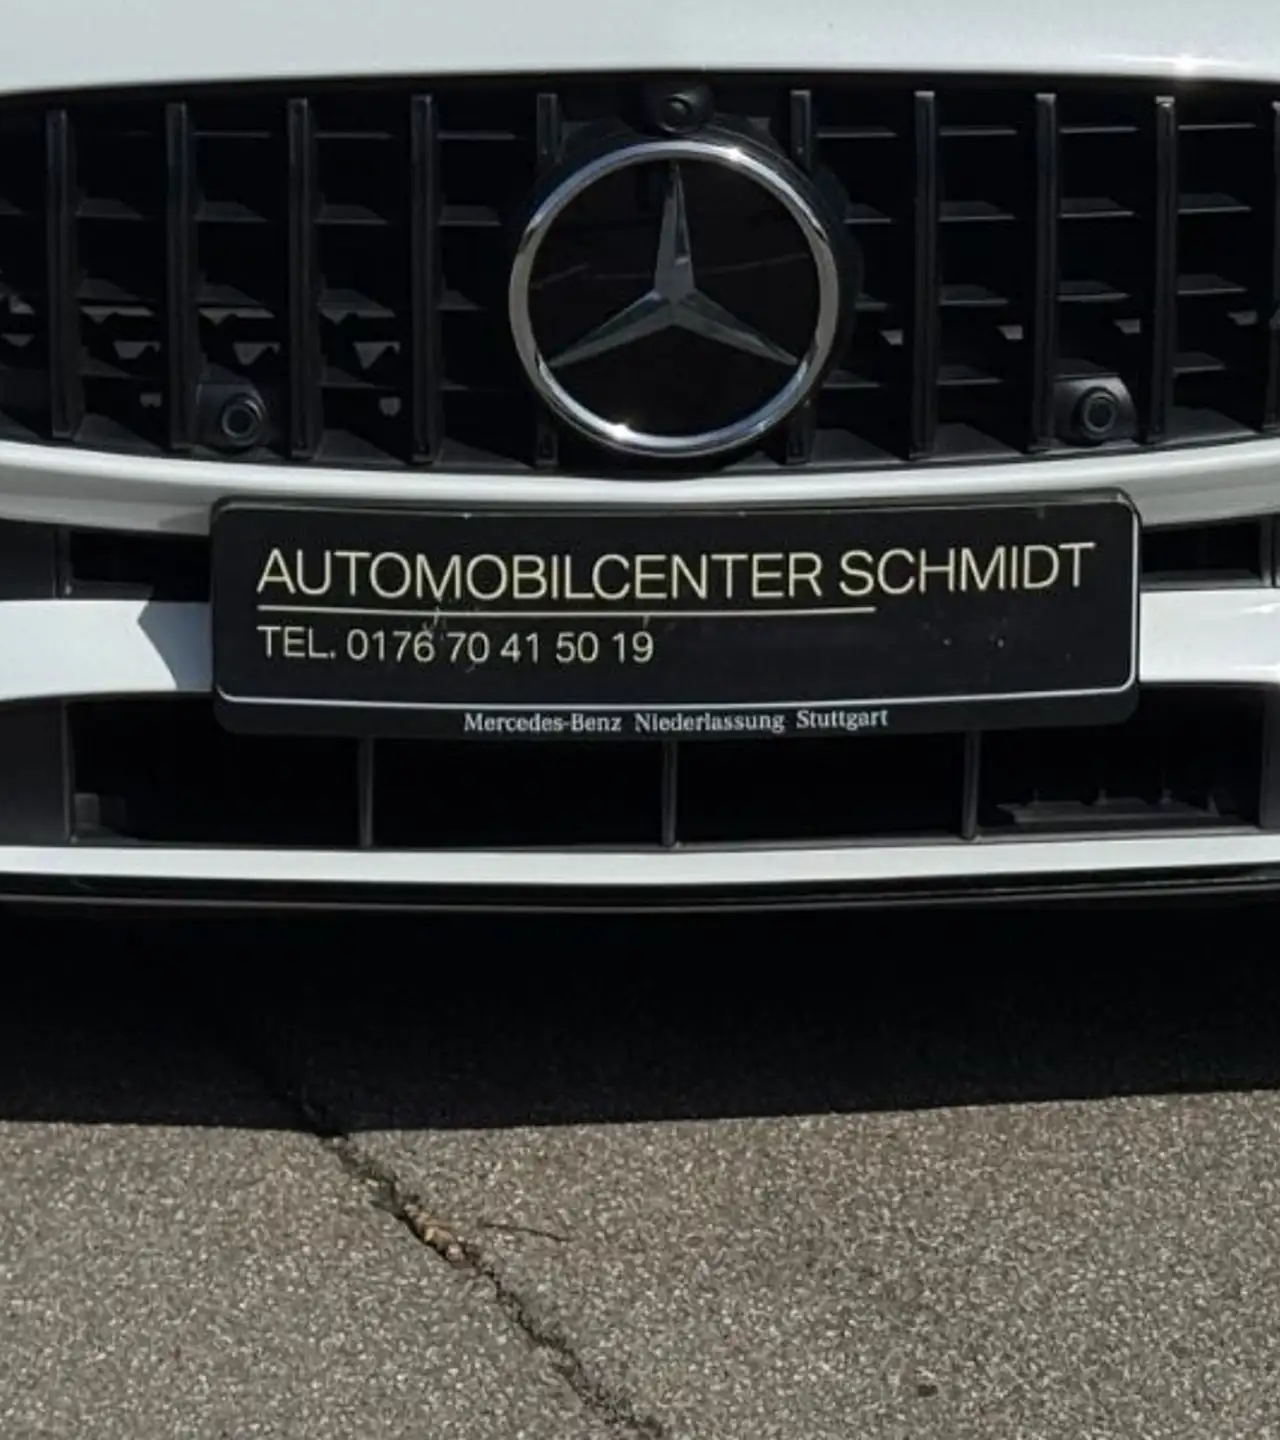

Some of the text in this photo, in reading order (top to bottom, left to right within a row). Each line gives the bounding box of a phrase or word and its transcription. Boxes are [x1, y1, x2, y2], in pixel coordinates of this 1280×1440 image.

[256, 541, 1096, 602] AUTOMOBILCENTER SCHMIDT
[256, 625, 654, 663] TEL. 0176 70 41 50 19
[463, 709, 889, 734] Mercedes-Benz Niederlassung Stuttgart
